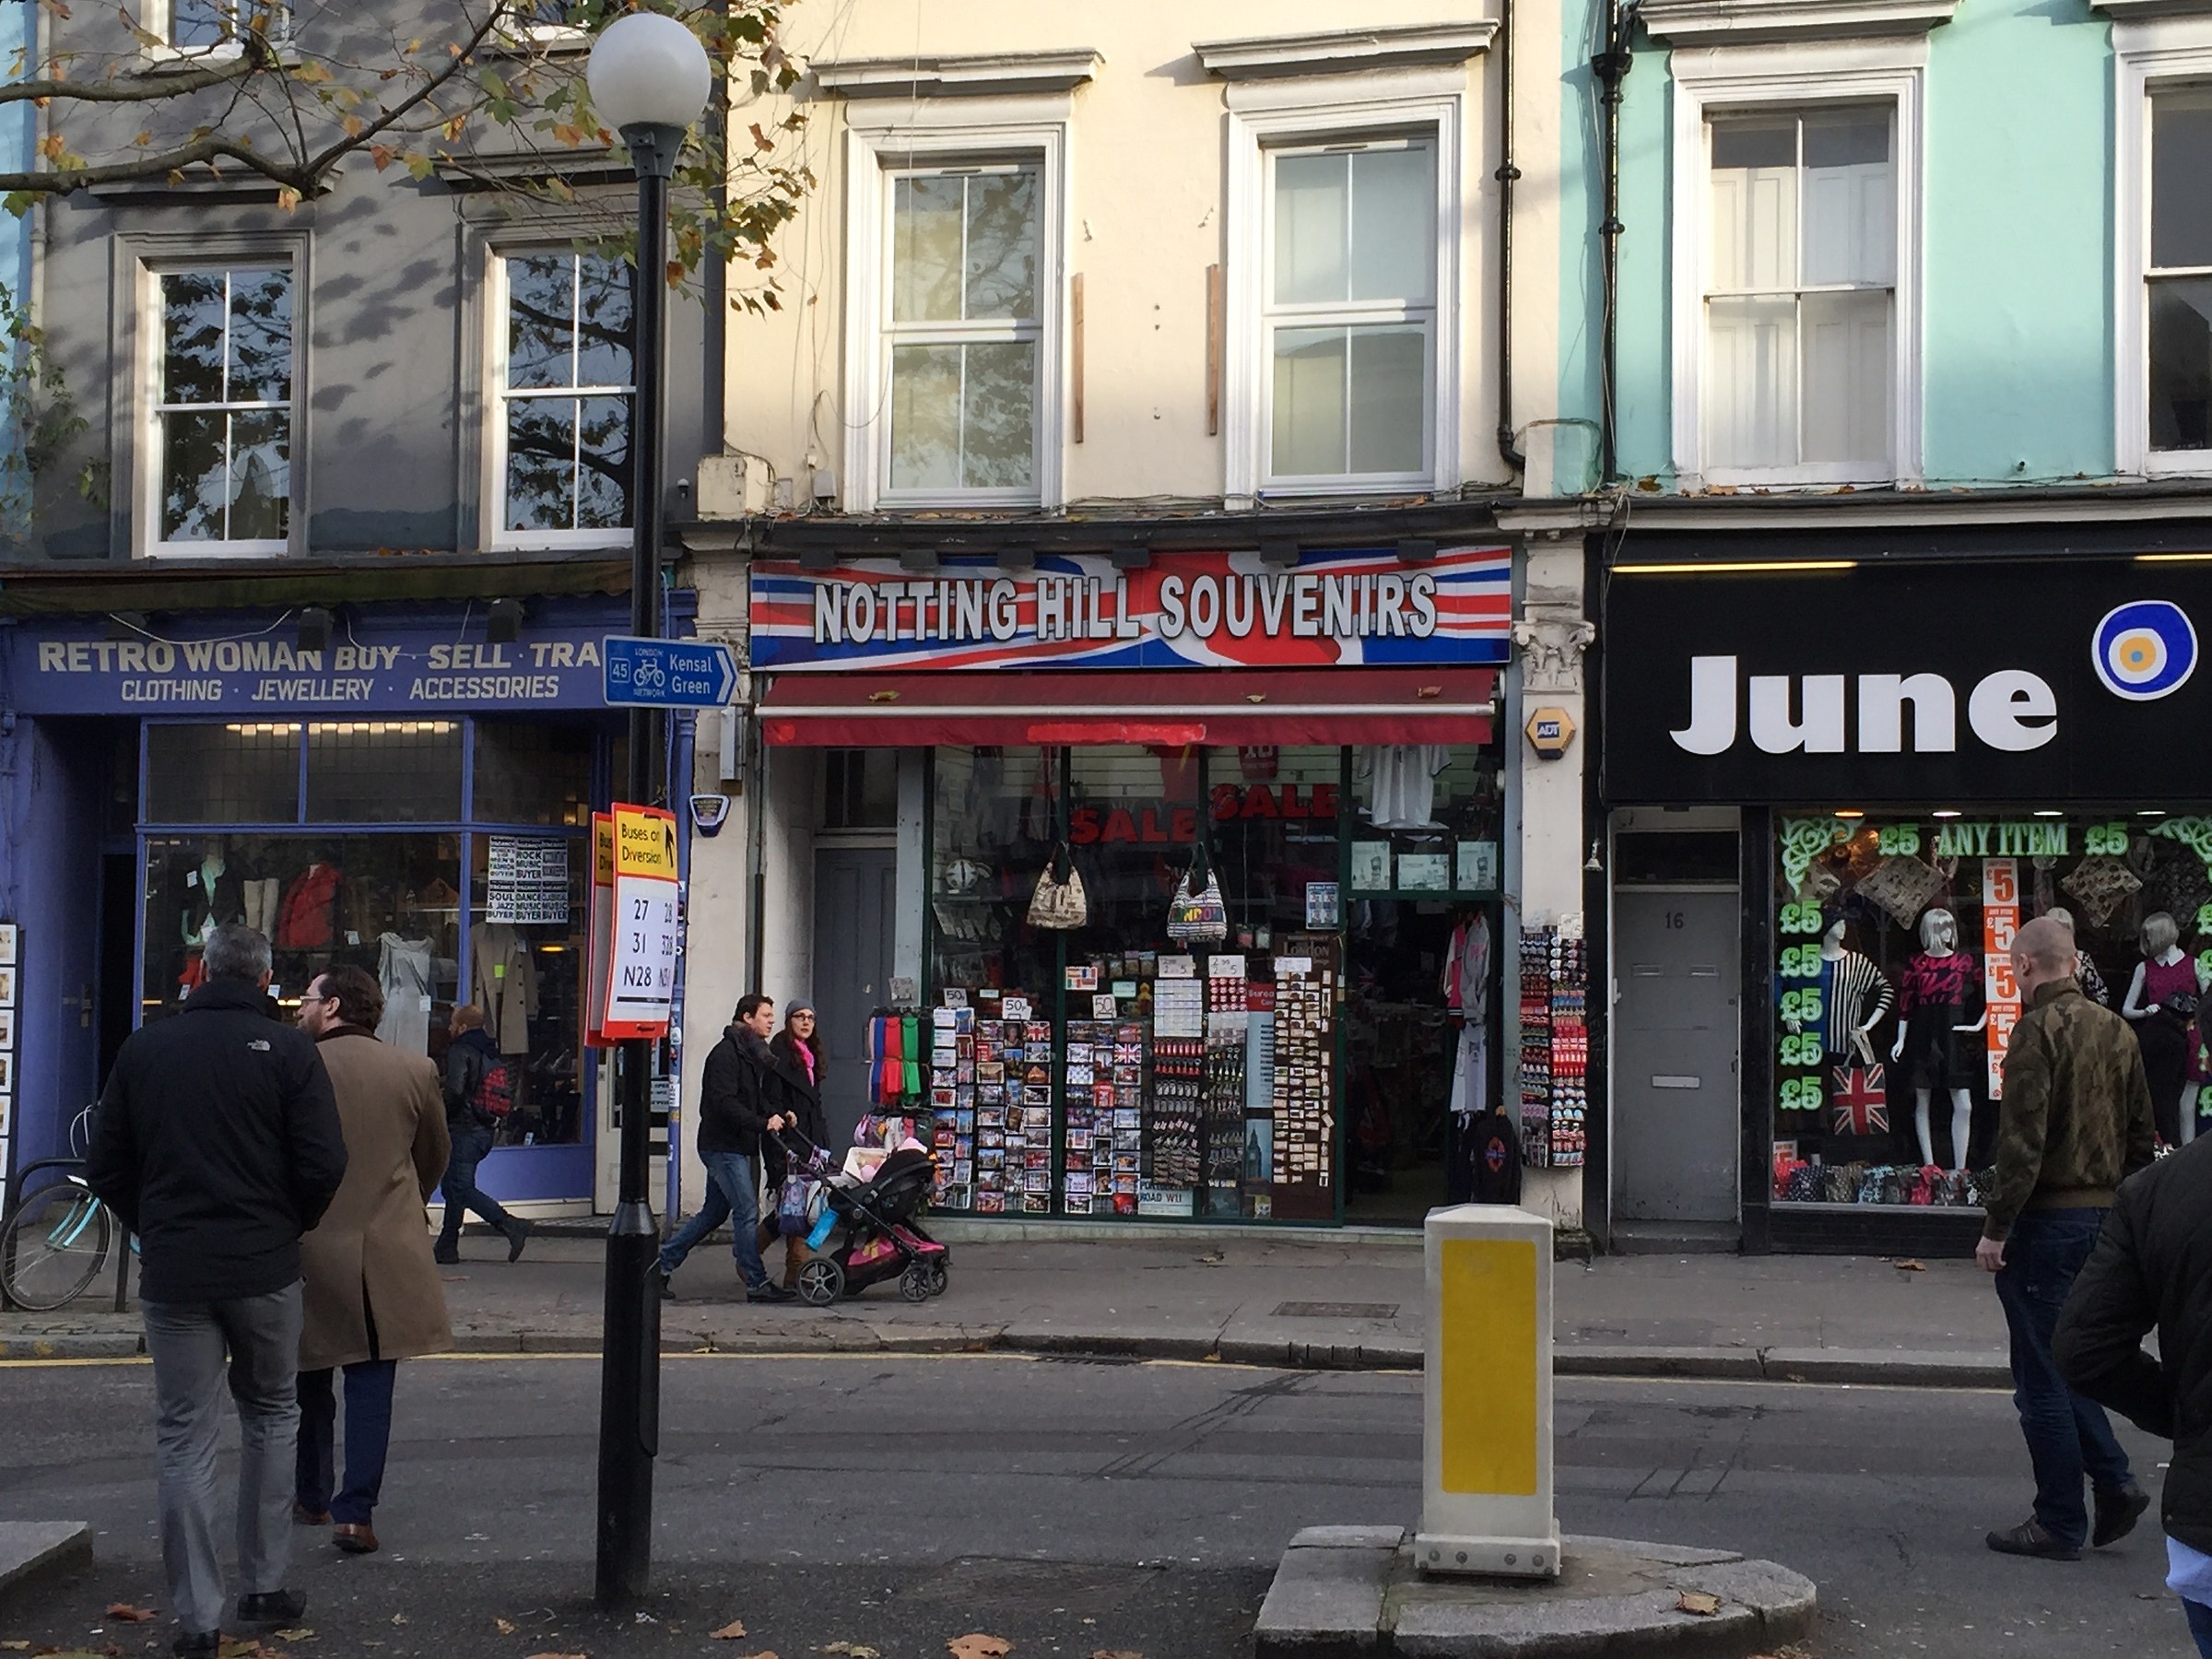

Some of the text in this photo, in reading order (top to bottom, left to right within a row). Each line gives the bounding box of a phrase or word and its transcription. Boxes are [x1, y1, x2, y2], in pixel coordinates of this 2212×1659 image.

[814, 573, 1438, 643] NOTTING HILL SOUVENIRS
[39, 641, 600, 673] RETRO WOMAN BUY SELL TRA
[635, 648, 664, 657] LONDON
[669, 653, 712, 673] Kensal
[612, 663, 628, 677] 45
[122, 676, 559, 701] CLOTHING JEWELLERY ACCESSORIES
[671, 676, 711, 694] Green
[1669, 655, 2057, 755] June
[1537, 724, 1559, 735] ADT
[1212, 783, 1339, 819] SALE
[621, 823, 661, 842] Buses on
[1070, 807, 1196, 845] SALE
[1878, 822, 2129, 856] £5 ANY ITEM £5
[516, 860, 541, 868] MUSIC
[622, 846, 662, 865] Diversion
[516, 870, 541, 878] BUYER
[489, 892, 514, 900] SOUL
[1986, 869, 2014, 902] £5
[516, 911, 541, 920] BUYER
[634, 899, 649, 921] 27
[665, 902, 673, 924] 28
[1665, 912, 1684, 929] 16
[1780, 900, 1823, 934] £5
[632, 932, 646, 954] 31
[1986, 917, 2016, 951] £5
[1780, 944, 1823, 978] £5
[624, 966, 652, 987] N28
[1989, 966, 2017, 998] £5
[1006, 1000, 1026, 1011] 50p
[1780, 988, 1823, 1022] £5
[1780, 1032, 1823, 1066] £5
[1780, 1076, 1823, 1111] £5
[1140, 1193, 1162, 1202] ROAD
